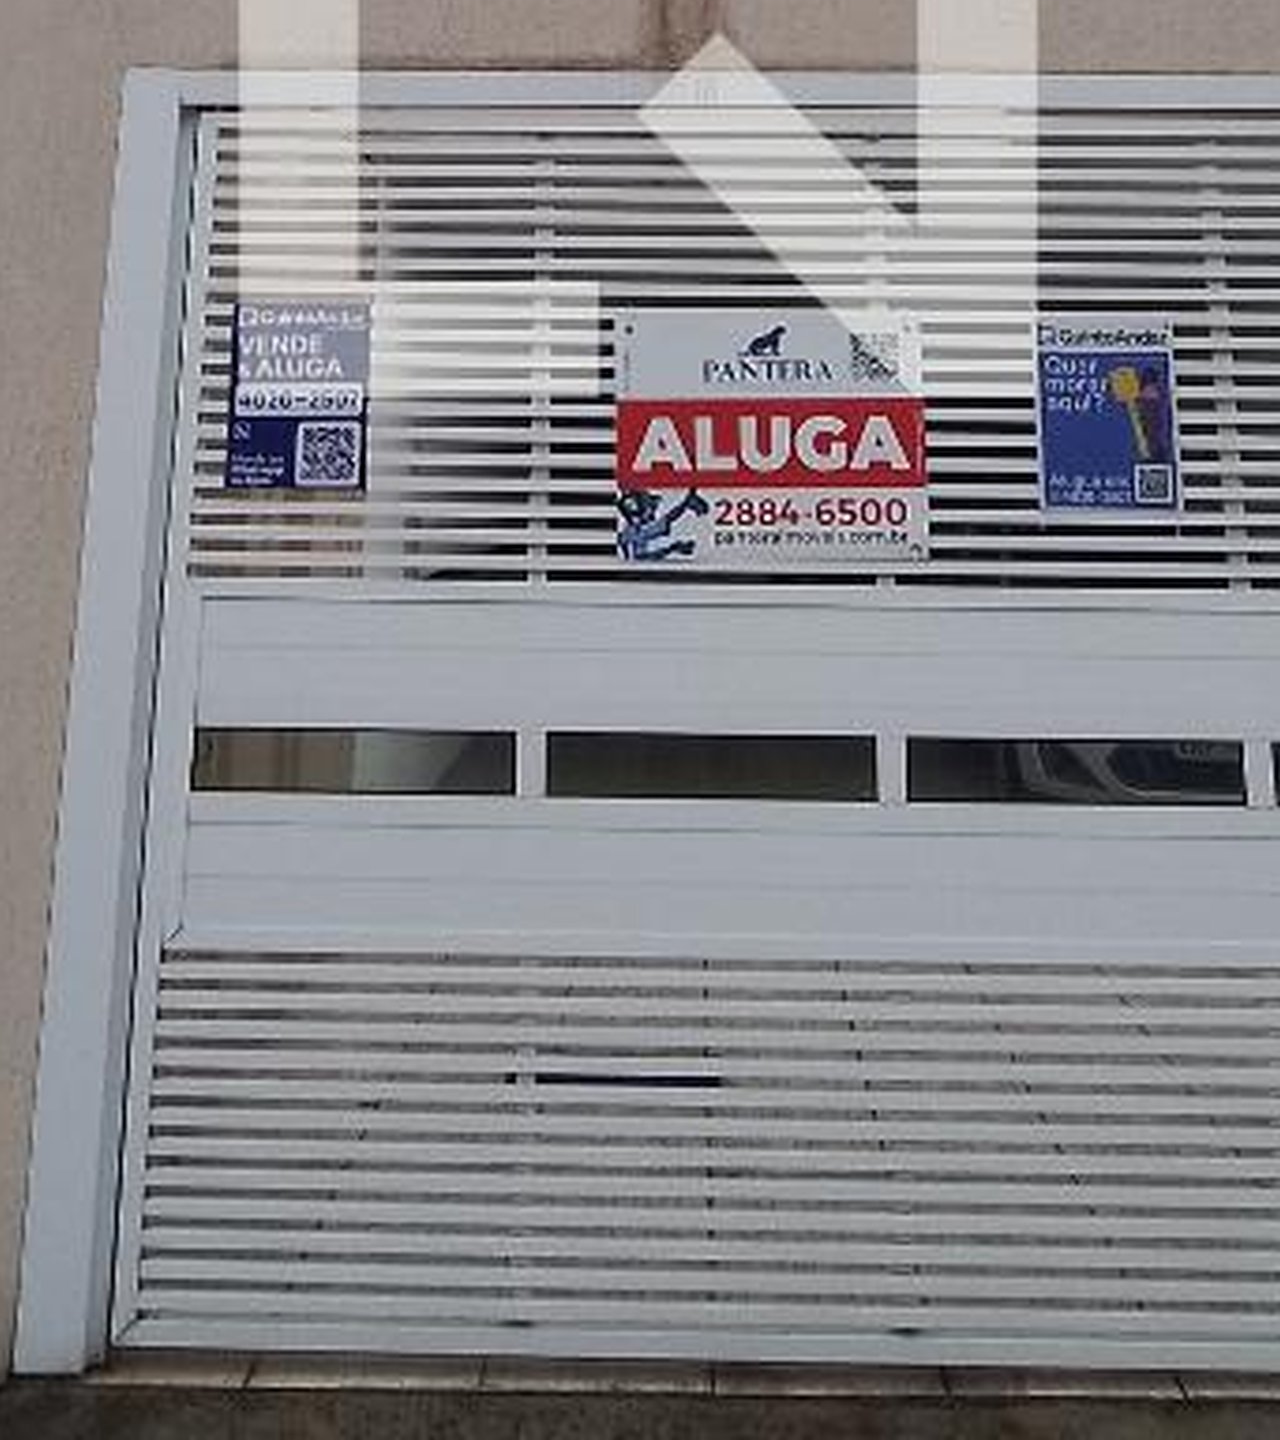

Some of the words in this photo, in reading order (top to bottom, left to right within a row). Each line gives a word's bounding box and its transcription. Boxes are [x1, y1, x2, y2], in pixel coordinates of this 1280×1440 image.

[238, 334, 324, 355] VENDE
[255, 358, 345, 378] ALUGA
[702, 359, 833, 382] PANTERA
[1044, 356, 1099, 375] Quer
[631, 415, 912, 472] ALUGA
[714, 498, 908, 526] 2884-6500
